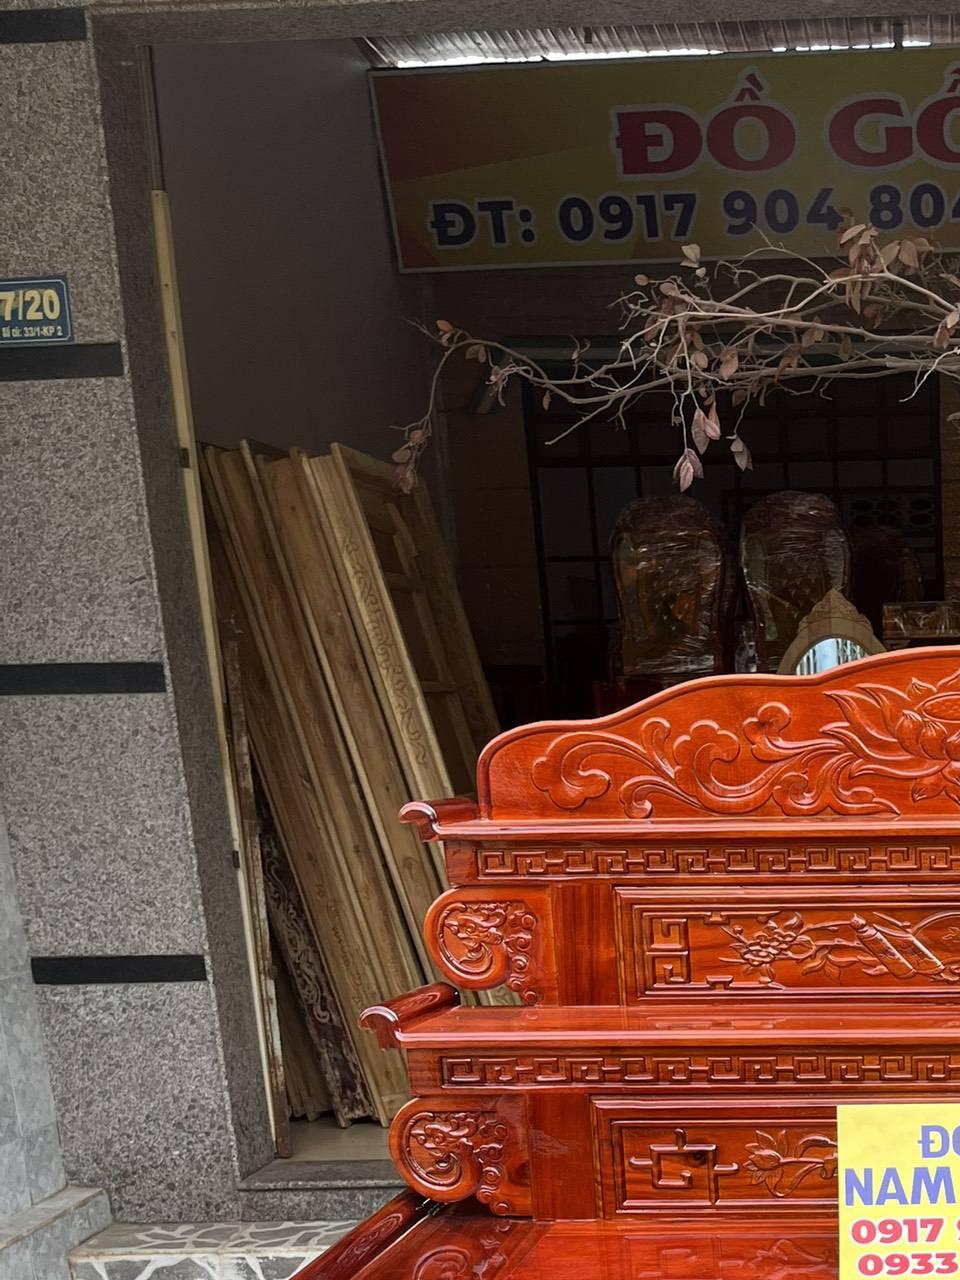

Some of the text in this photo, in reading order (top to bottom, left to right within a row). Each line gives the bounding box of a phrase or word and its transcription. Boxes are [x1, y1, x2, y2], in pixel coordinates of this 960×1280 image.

[614, 72, 797, 176] ĐỒ
[430, 200, 536, 246] ĐT:
[559, 192, 698, 242] 0917
[722, 187, 845, 235] 904
[844, 1165, 957, 1207] NAM
[851, 1217, 945, 1245] 0917
[857, 1251, 959, 1276] 0933
